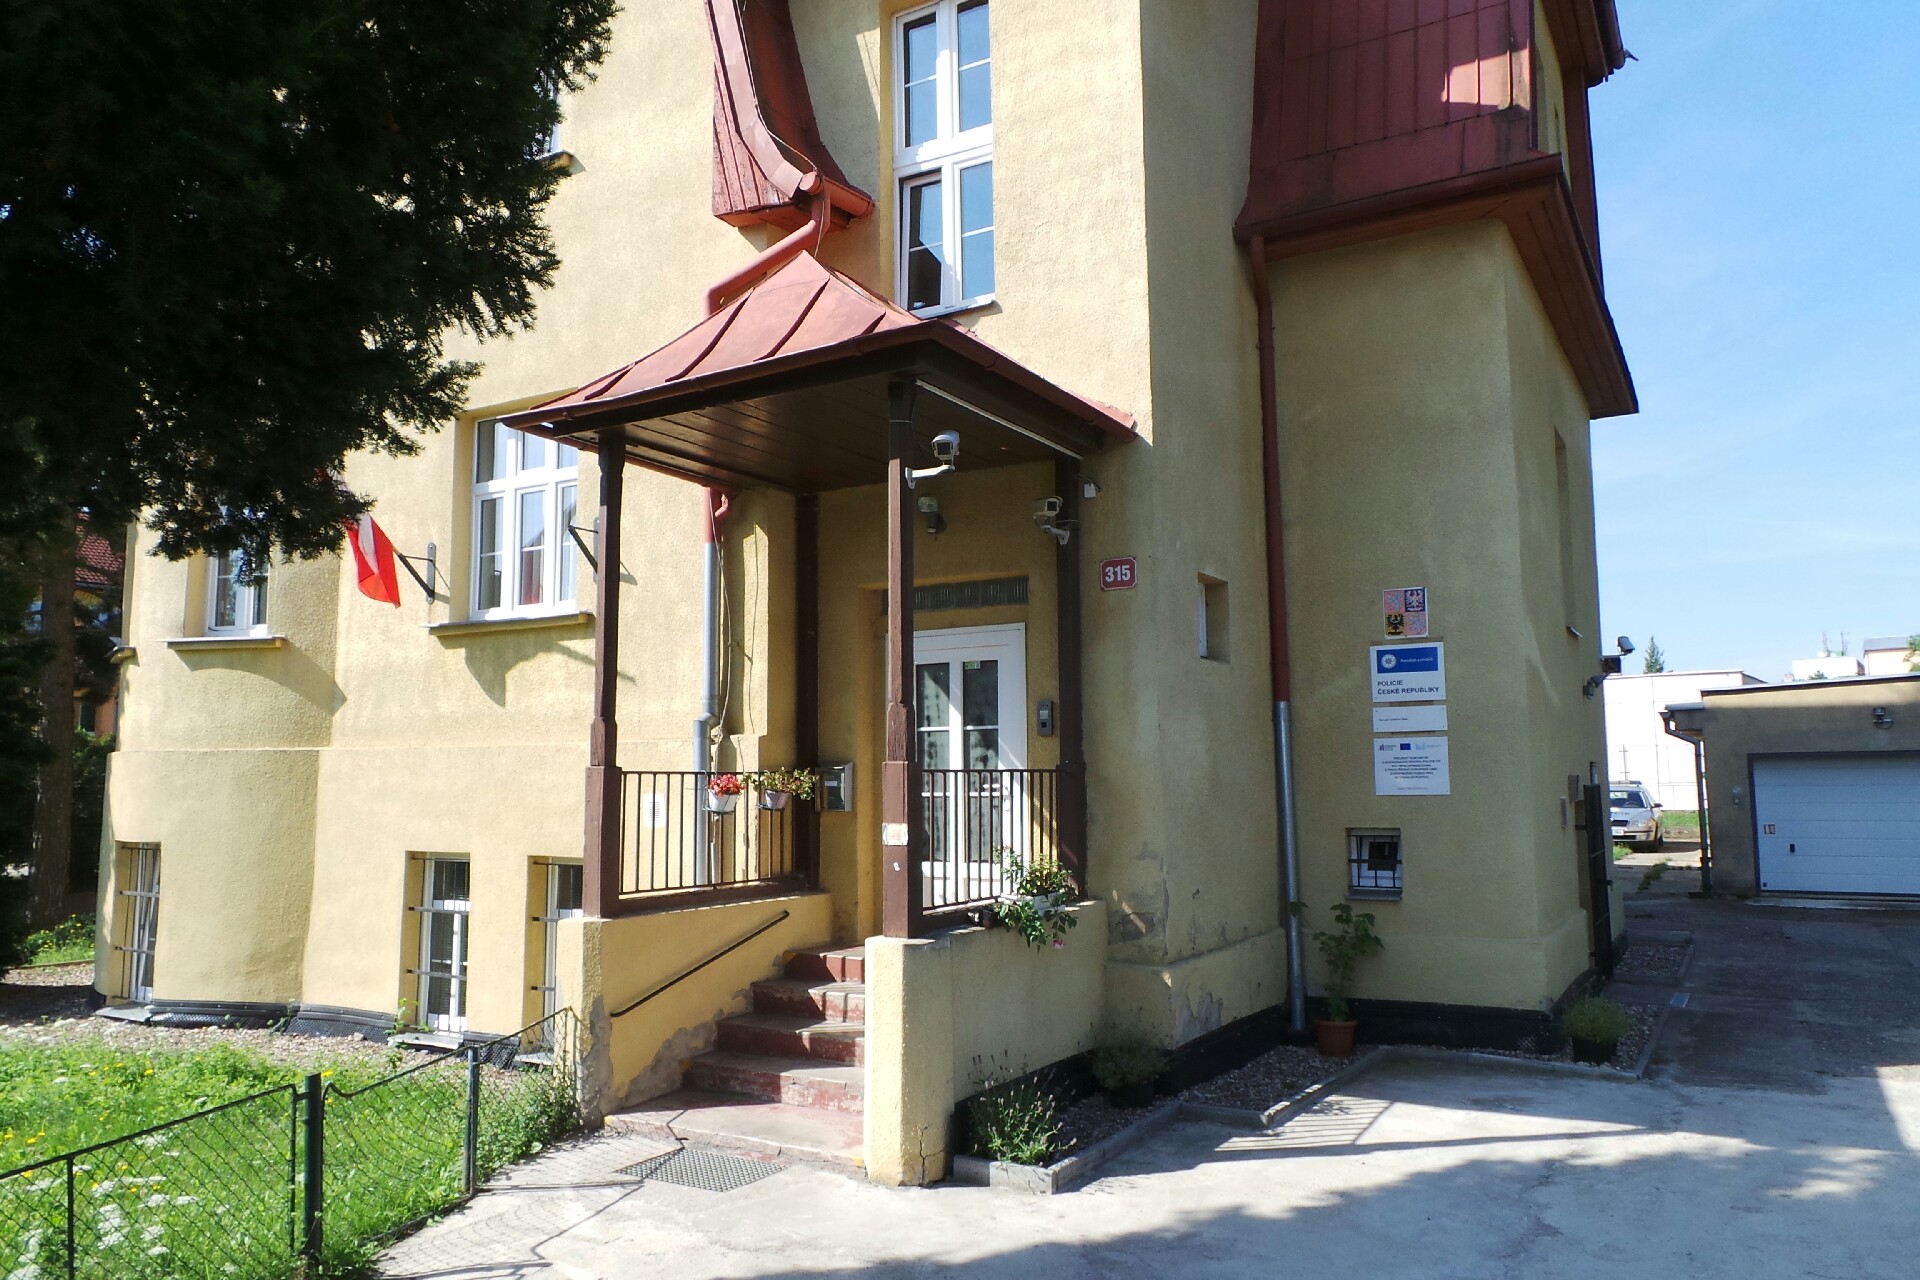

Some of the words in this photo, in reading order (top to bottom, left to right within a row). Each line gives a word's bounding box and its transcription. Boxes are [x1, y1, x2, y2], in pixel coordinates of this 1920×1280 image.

[1105, 565, 1131, 582] 315
[1377, 687, 1400, 695] ČESKÉ
[1401, 686, 1440, 694] REPUBLIKY
